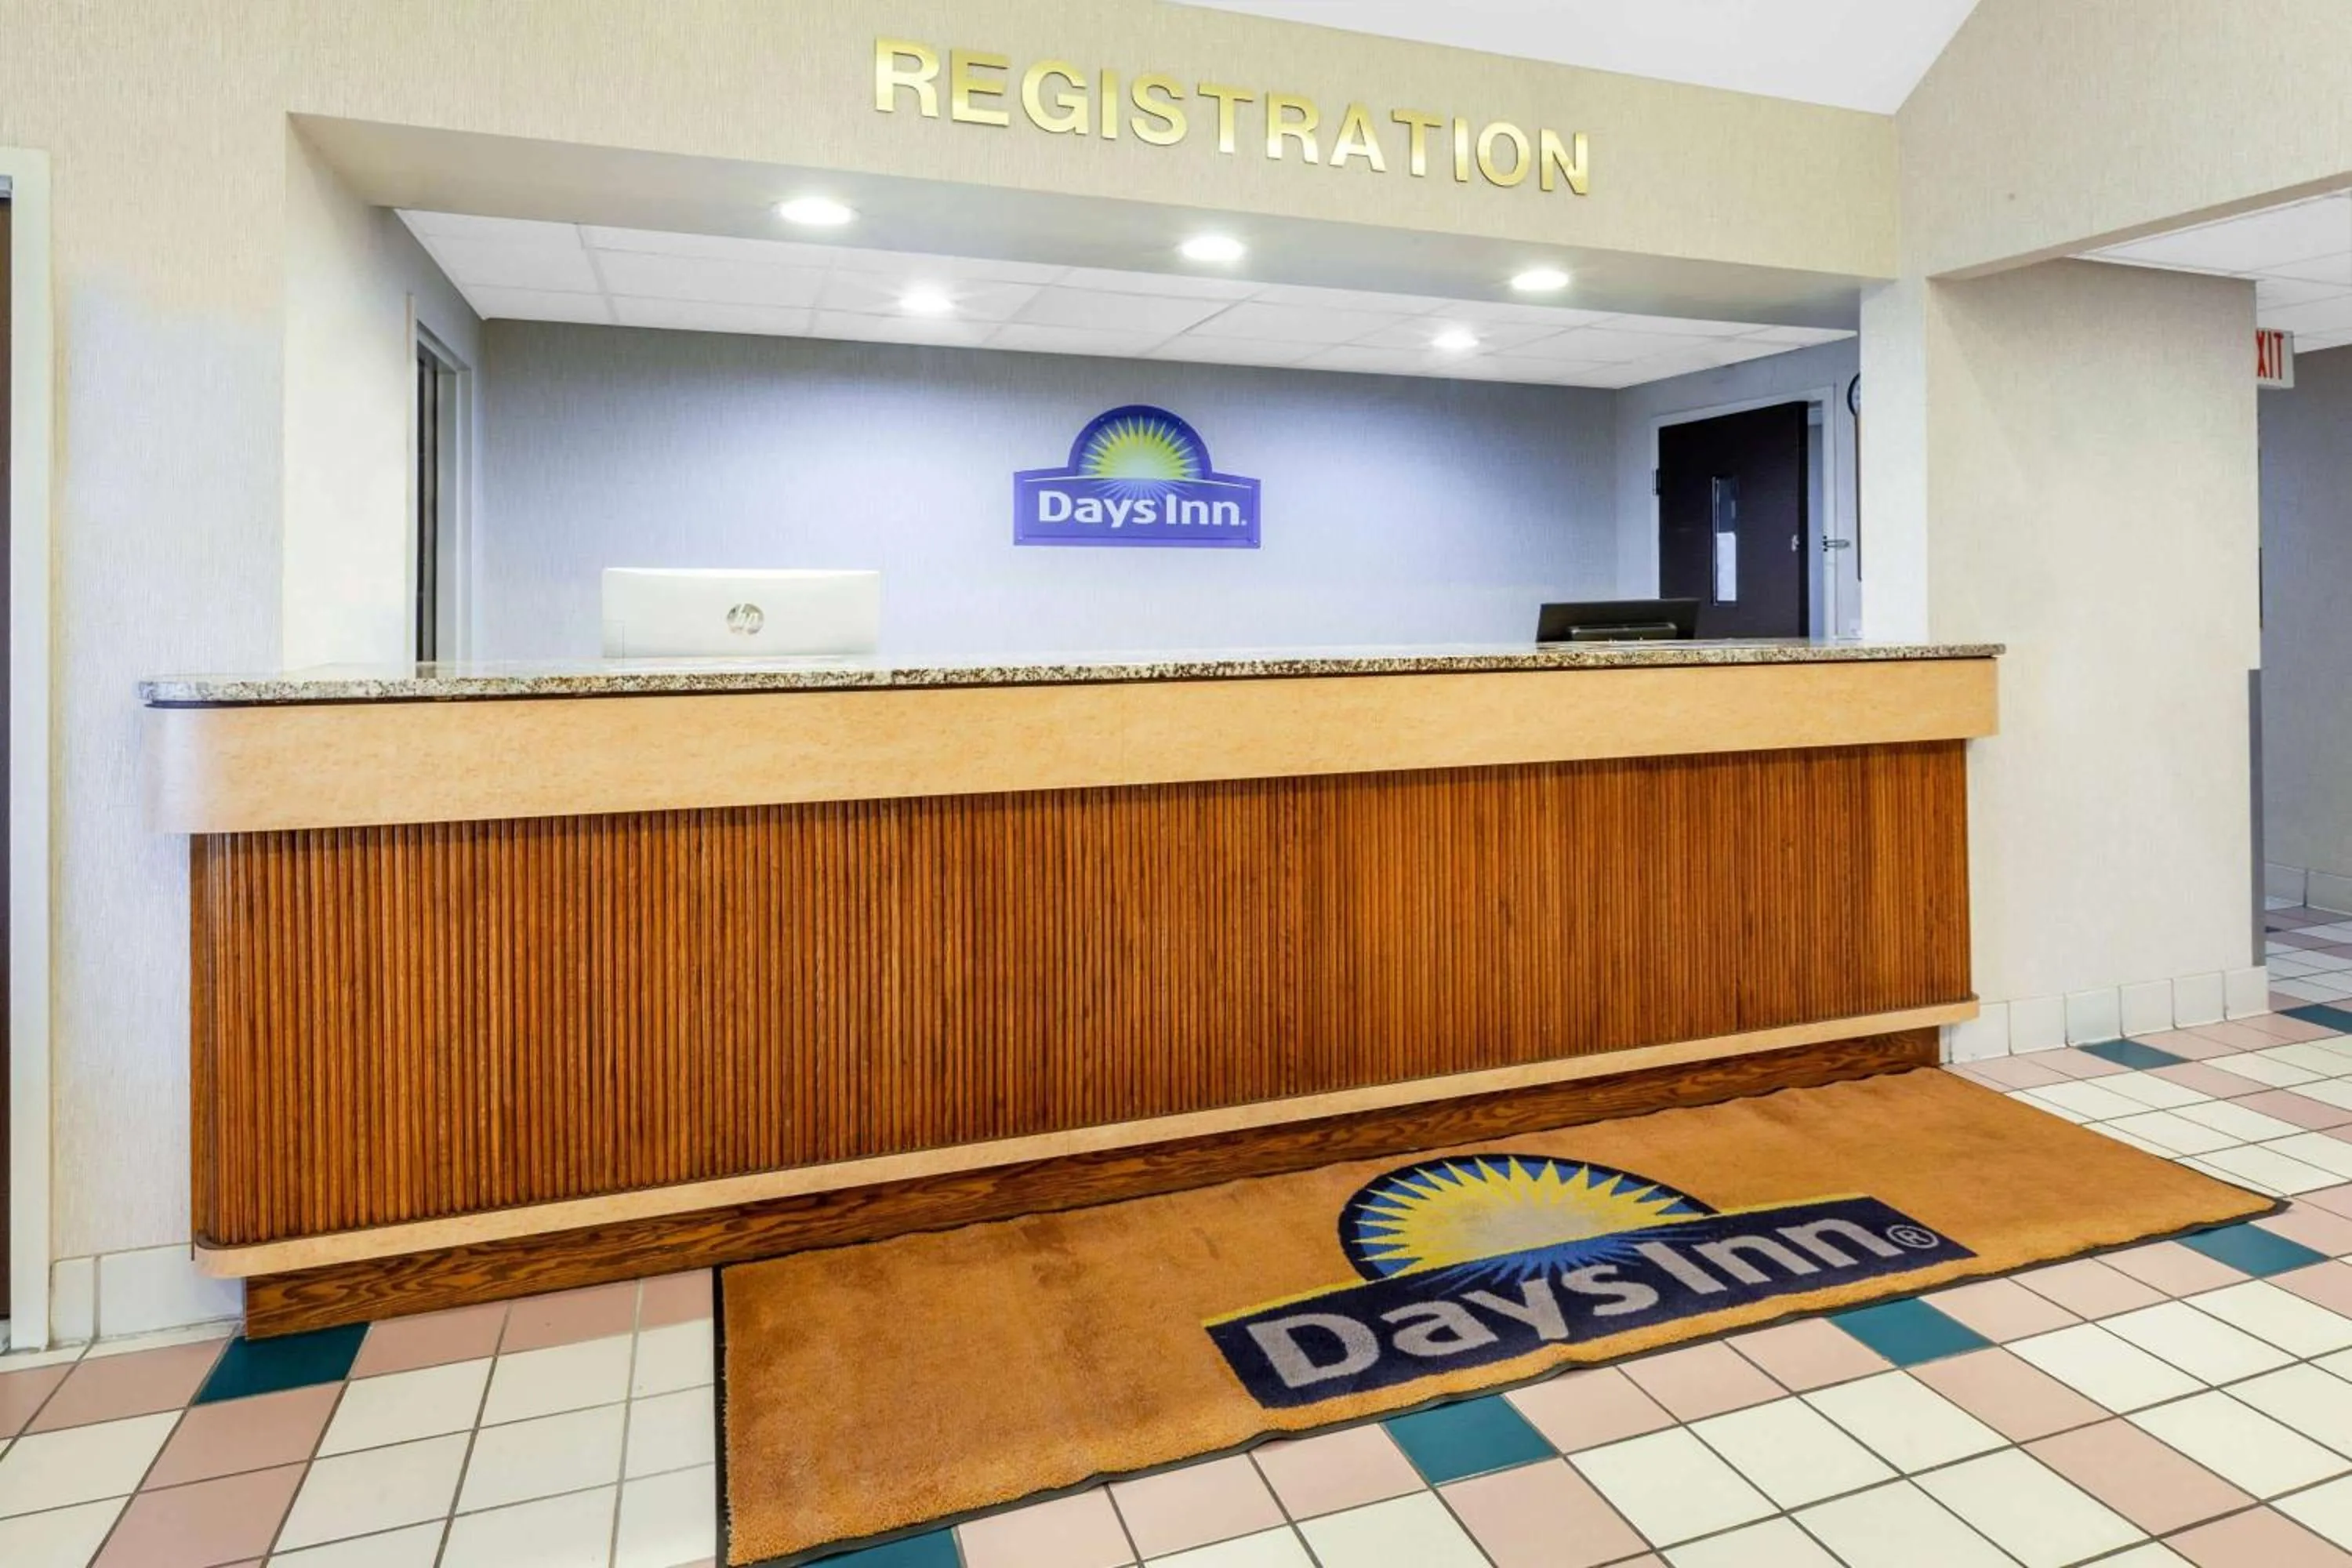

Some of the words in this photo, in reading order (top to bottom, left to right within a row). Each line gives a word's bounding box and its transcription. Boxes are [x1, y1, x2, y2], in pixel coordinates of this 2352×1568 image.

[874, 38, 1589, 195] REGISTRATION
[2256, 329, 2284, 380] XIT
[1038, 490, 1157, 528] Days
[730, 603, 762, 636] hp
[1247, 1259, 1660, 1389] Days
